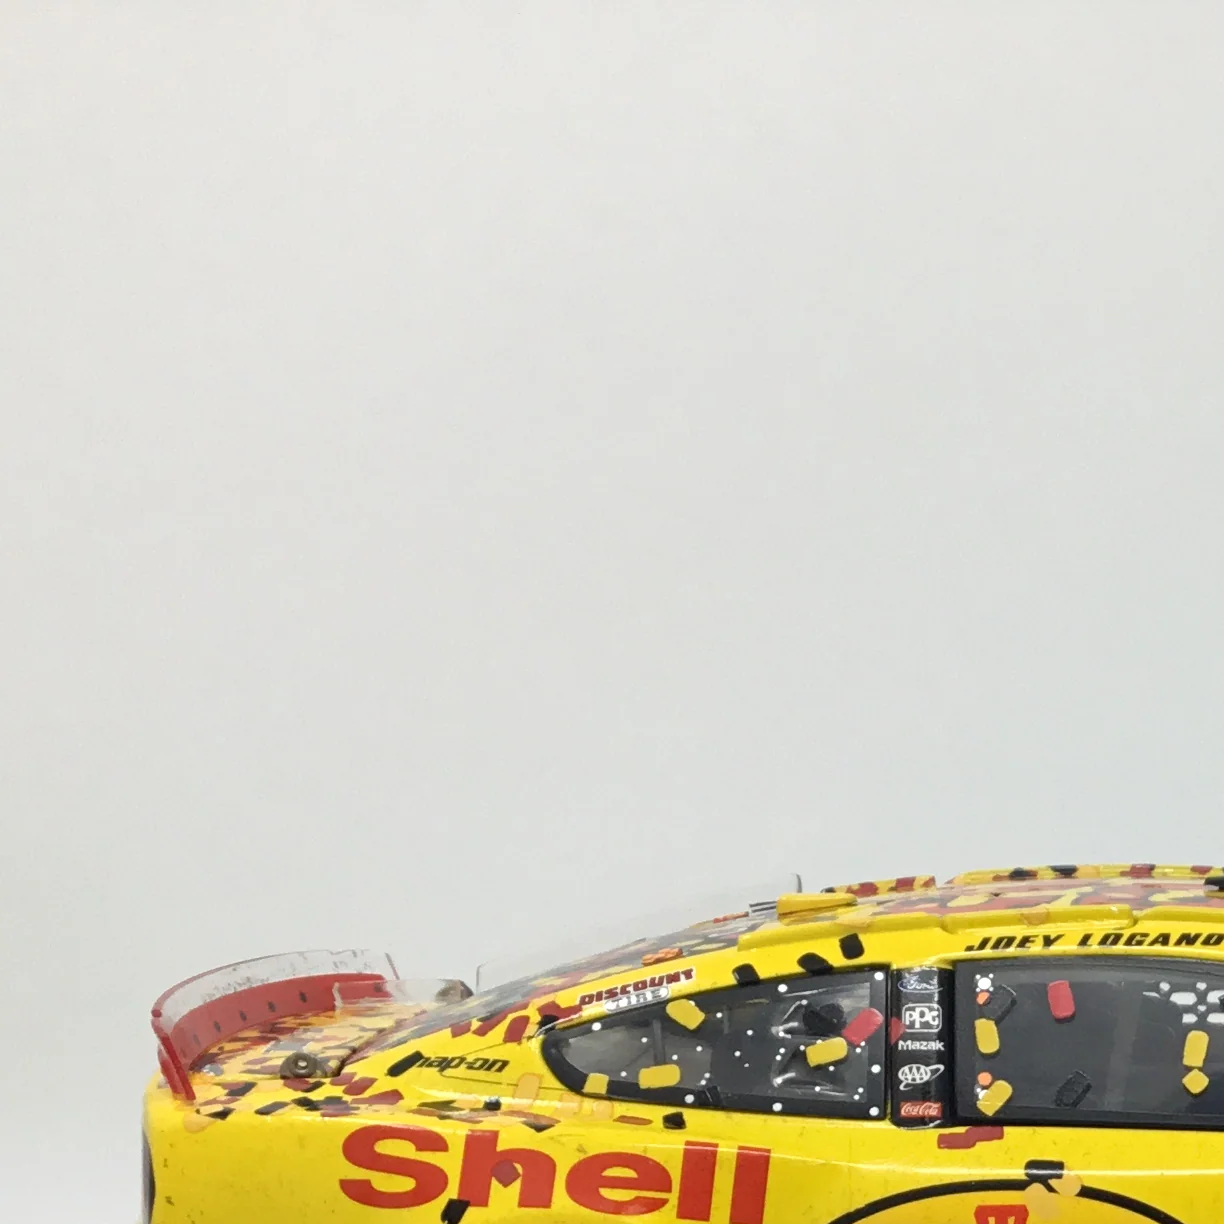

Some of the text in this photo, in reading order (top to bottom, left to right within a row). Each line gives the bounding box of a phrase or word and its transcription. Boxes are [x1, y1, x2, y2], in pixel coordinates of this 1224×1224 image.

[964, 933, 1064, 952] JOEY
[578, 967, 695, 1006] DISCOUNT
[905, 1007, 939, 1029] PPG
[898, 1040, 945, 1051] Mazak
[387, 1055, 510, 1076] nap-on
[902, 1066, 928, 1083] AAA
